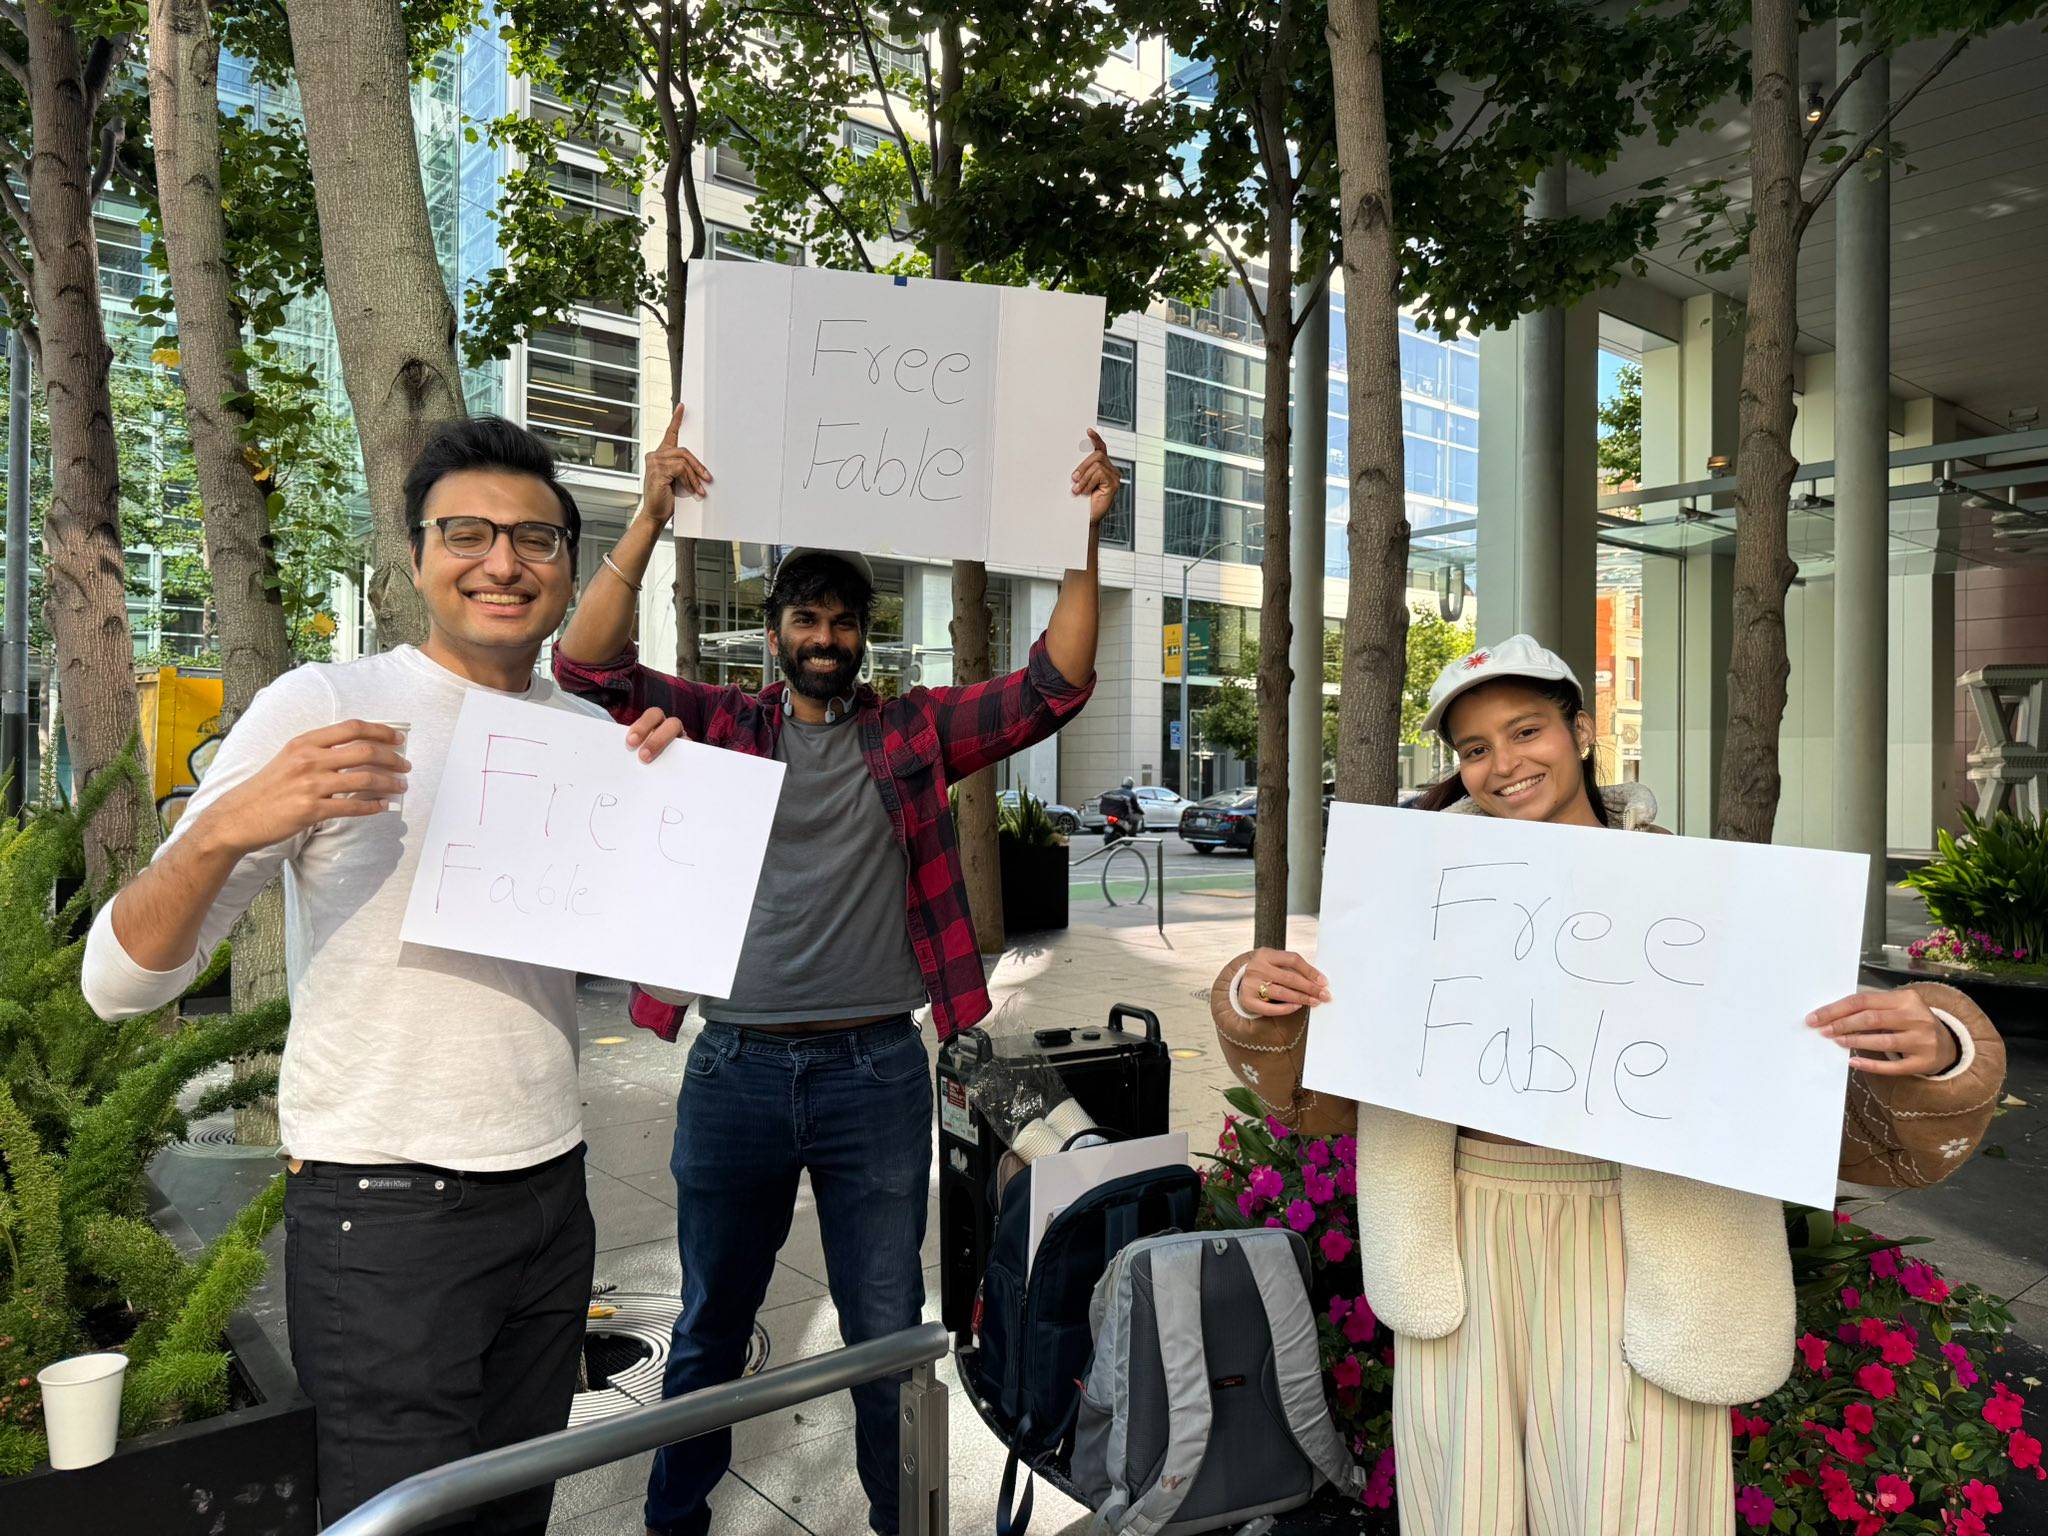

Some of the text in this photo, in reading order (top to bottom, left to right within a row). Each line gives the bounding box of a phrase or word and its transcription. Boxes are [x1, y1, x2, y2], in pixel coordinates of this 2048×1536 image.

[812, 318, 971, 405] Free
[803, 418, 965, 502] Fable
[478, 734, 696, 867] Free
[434, 842, 602, 916] Fable
[1430, 861, 1707, 987] Free
[1415, 975, 1674, 1120] Fable
